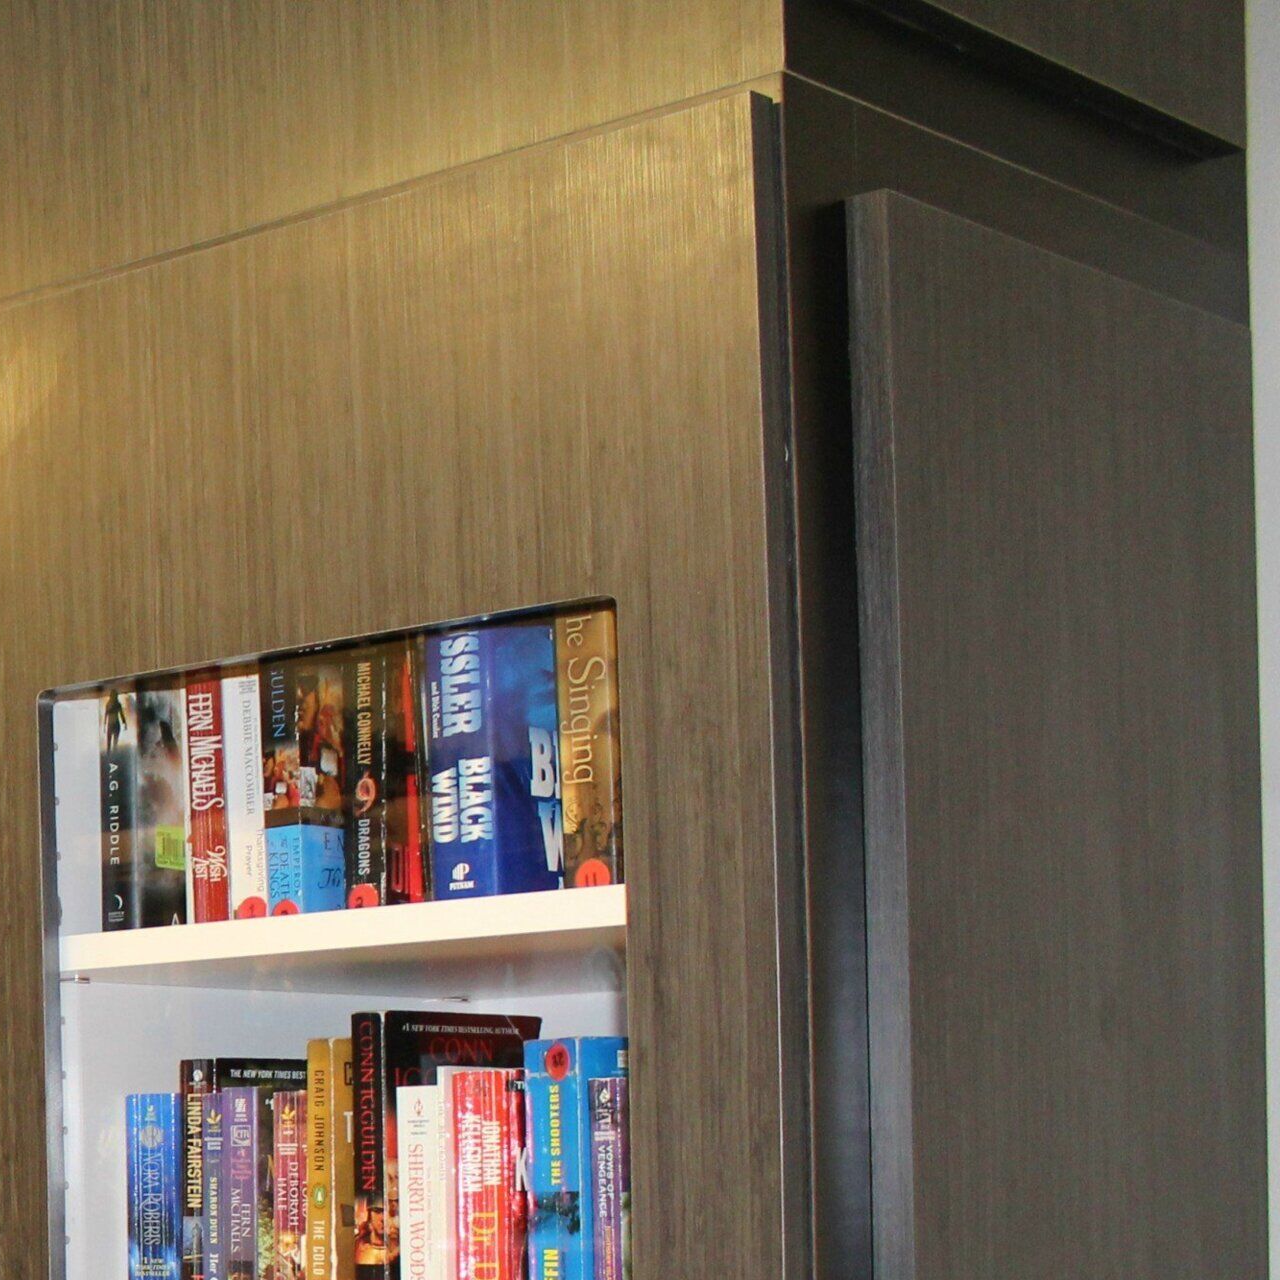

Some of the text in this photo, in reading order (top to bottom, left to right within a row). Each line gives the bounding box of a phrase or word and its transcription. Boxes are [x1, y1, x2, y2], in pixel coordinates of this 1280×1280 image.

[187, 692, 215, 731] FERN
[357, 662, 371, 765] MICHAEL CONNELLY
[439, 630, 482, 738] SSLER
[560, 613, 606, 785] he Singing
[241, 700, 257, 816] DEBBIE MACOMBER
[108, 762, 121, 866] A.G. RIDDLE
[431, 767, 458, 844] WIND
[458, 755, 494, 843] BLACK
[208, 844, 228, 883] WISH
[268, 851, 280, 899] KINGS
[357, 819, 371, 875] DRAGONS
[230, 1068, 306, 1081] THE NEW YORK TIMES BEST
[358, 1020, 374, 1084] CONN
[430, 1036, 493, 1063] CONN
[186, 1093, 203, 1209] LINDA FAIRSTEIN
[313, 1068, 326, 1172] CRAIG JOHNSON
[548, 1084, 561, 1186] THE SHOOTERS
[407, 1143, 424, 1217] SHERRYL
[460, 1113, 483, 1192] KELLERMAN
[483, 1119, 501, 1186] JONATHAN
[209, 1176, 218, 1217] SHARON
[241, 1203, 252, 1238] FERN
[277, 1176, 288, 1212] HALE
[288, 1161, 299, 1226] DEBORAH
[209, 1218, 218, 1245] DUNN
[313, 1219, 326, 1244] THE
[470, 1209, 499, 1248] Dr.
[208, 1253, 219, 1273] Her
[313, 1247, 326, 1279] COLD
